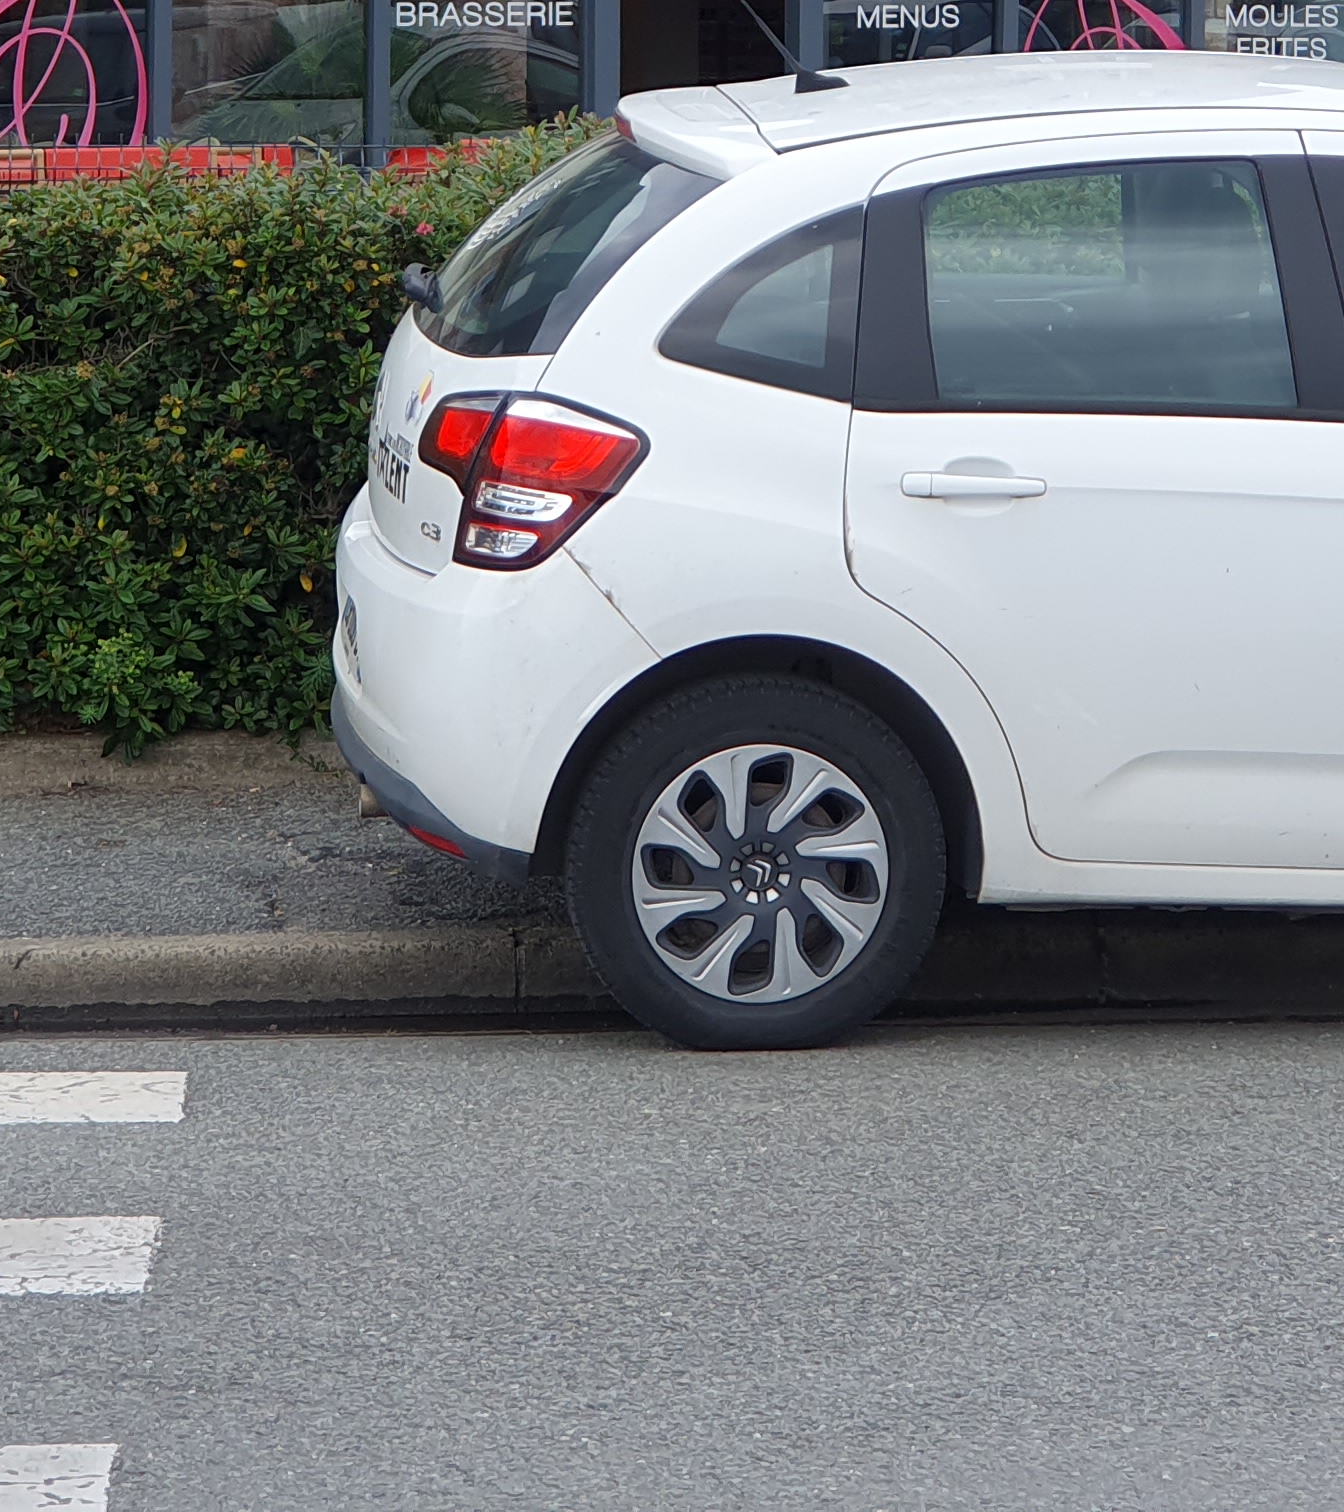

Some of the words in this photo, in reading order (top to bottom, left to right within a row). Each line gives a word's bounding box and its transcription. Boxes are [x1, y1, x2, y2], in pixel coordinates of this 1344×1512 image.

[396, 1, 574, 27] BRASSERIE
[857, 4, 960, 29] MENUS
[1225, 4, 1339, 28] MOULES
[1237, 37, 1327, 60] FRITES
[420, 521, 442, 542] C3
